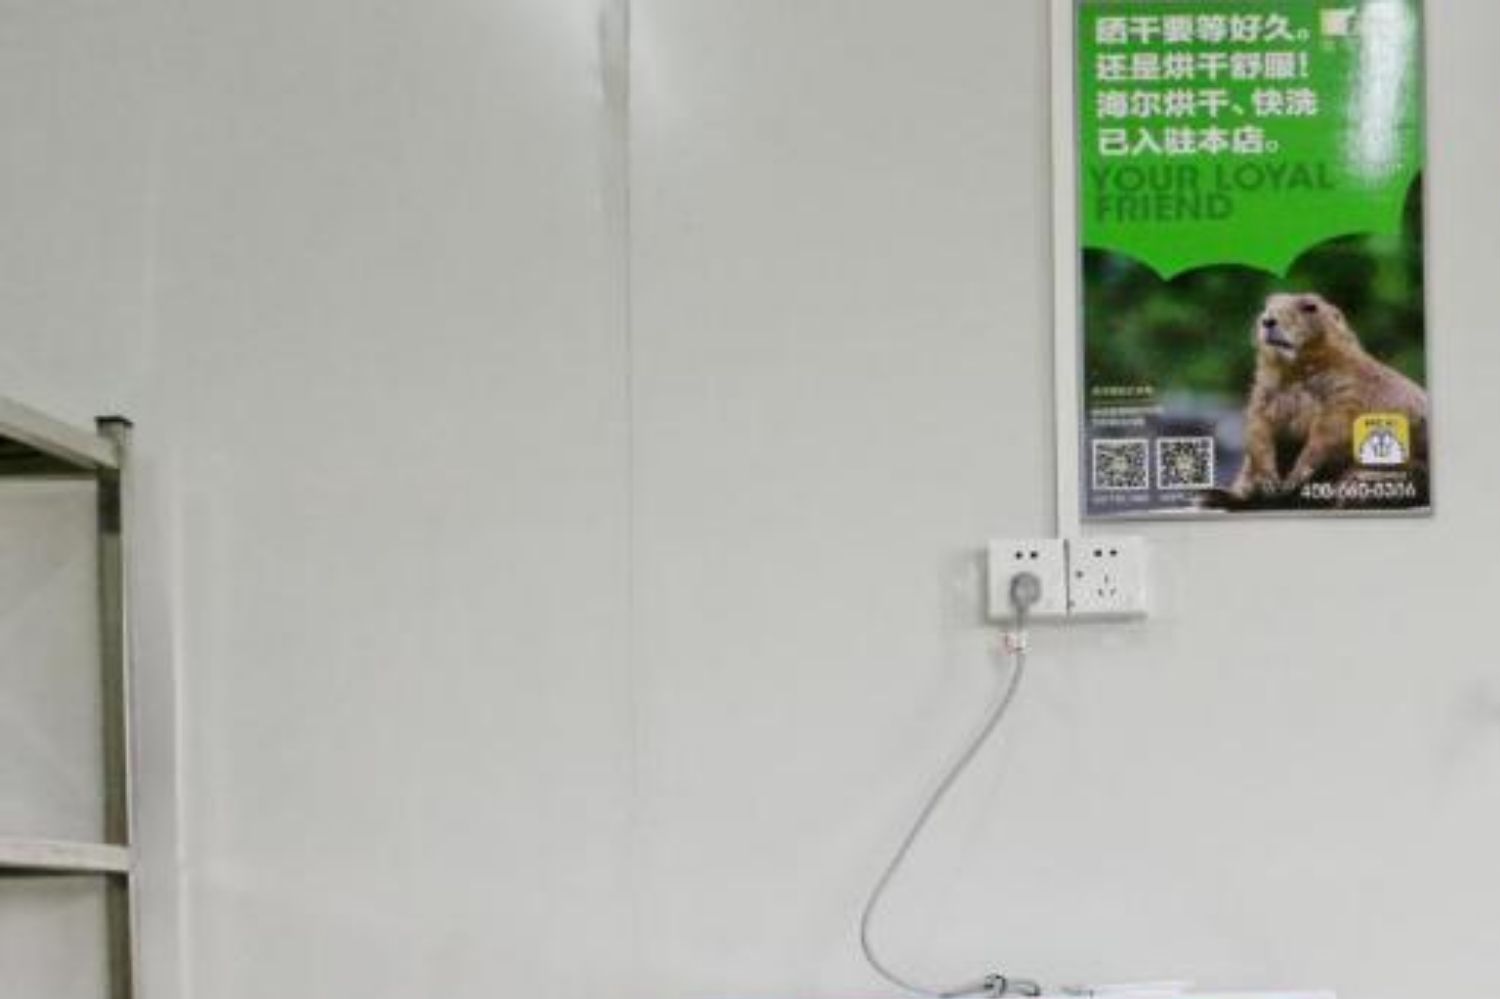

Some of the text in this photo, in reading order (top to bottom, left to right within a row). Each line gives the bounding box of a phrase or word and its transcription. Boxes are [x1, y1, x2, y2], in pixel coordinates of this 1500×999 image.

[1096, 89, 1319, 117] 海尔烘干、快洗
[1098, 126, 1279, 156] 已入驻本店。
[1091, 163, 1336, 192] YOUR LOYAL
[1096, 194, 1234, 222] FRIEND
